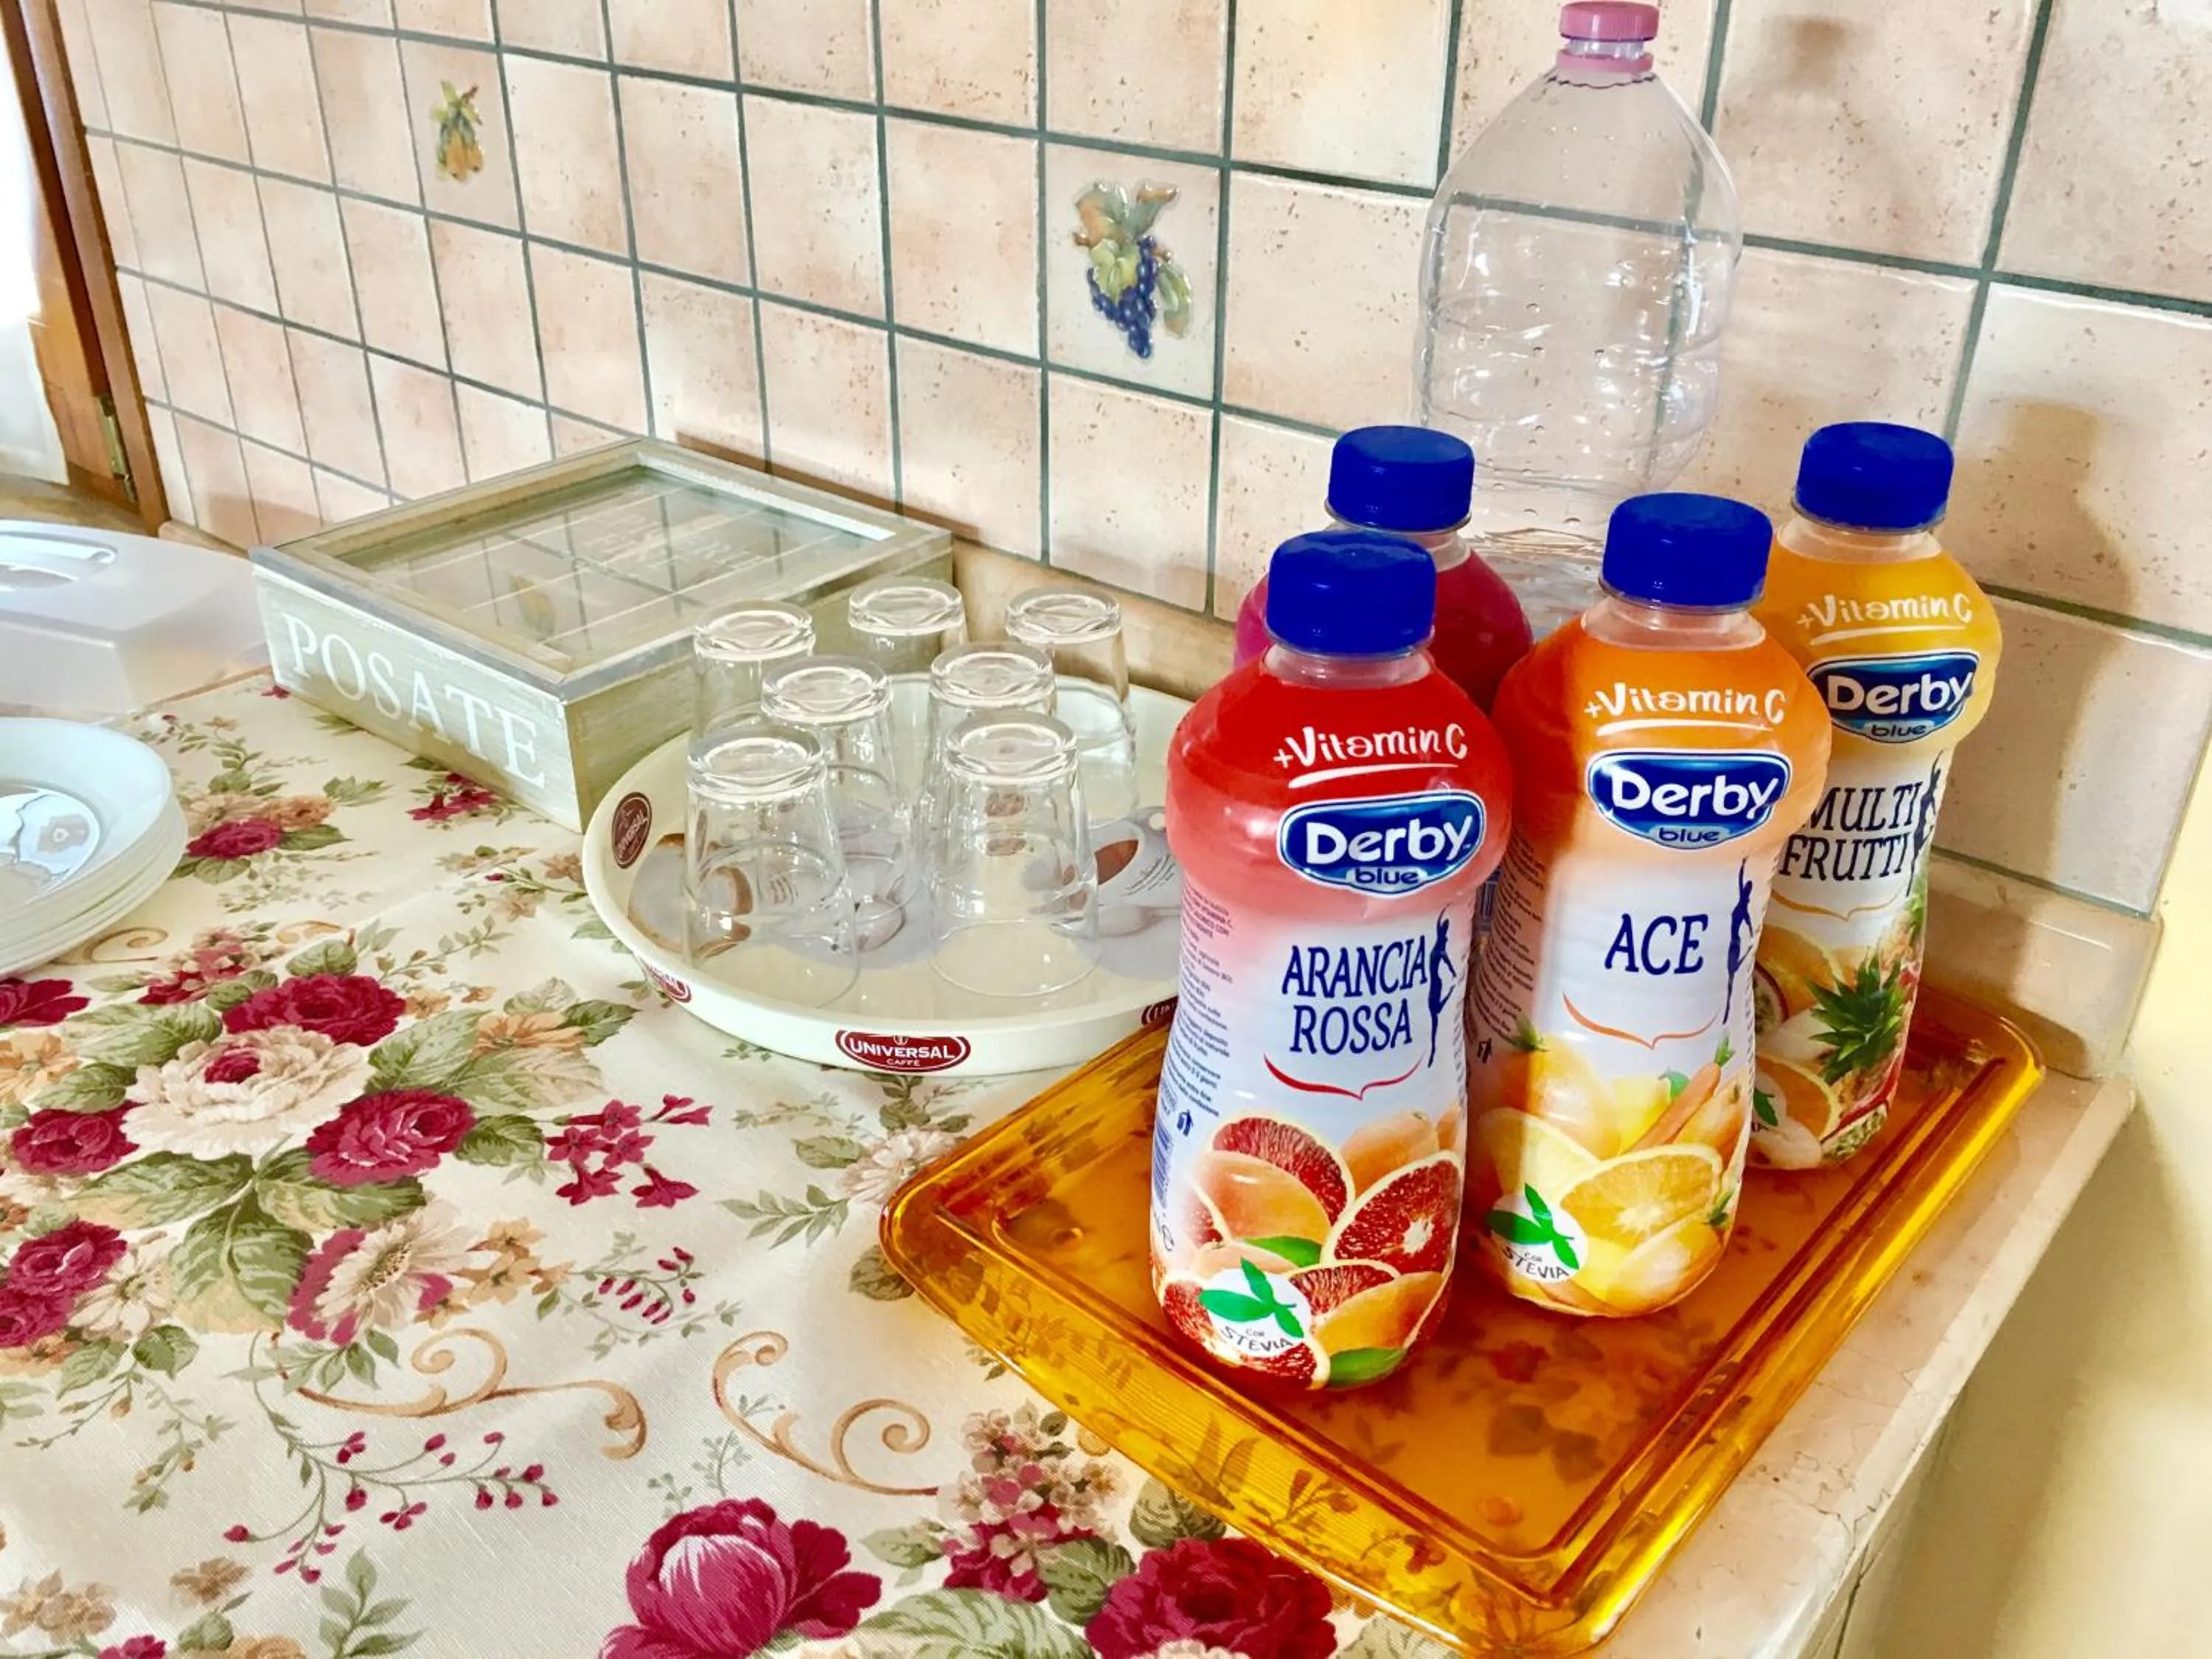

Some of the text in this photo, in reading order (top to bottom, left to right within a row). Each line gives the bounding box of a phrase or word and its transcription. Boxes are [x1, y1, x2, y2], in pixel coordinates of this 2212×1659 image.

[1953, 594, 1973, 624] C
[280, 612, 546, 790] POSATE
[1764, 689, 1786, 724] C
[1826, 672, 1973, 716] Derby
[1446, 723, 1468, 759] C
[1870, 721, 1927, 737] blue
[1610, 769, 1778, 820] Derby
[1801, 782, 1923, 832] MULTI
[1306, 815, 1472, 864] Derby
[1658, 827, 1720, 844] blue
[1354, 867, 1419, 886] blue
[1778, 831, 1911, 882] FRUTTI
[1604, 913, 1709, 975] ACE
[1281, 935, 1428, 999] ARANCIA
[1290, 998, 1413, 1055] ROSSA
[849, 1037, 956, 1059] UNIVERSAL
[1502, 1246, 1569, 1279] STEVIA
[1220, 1325, 1294, 1352] STEVIA
